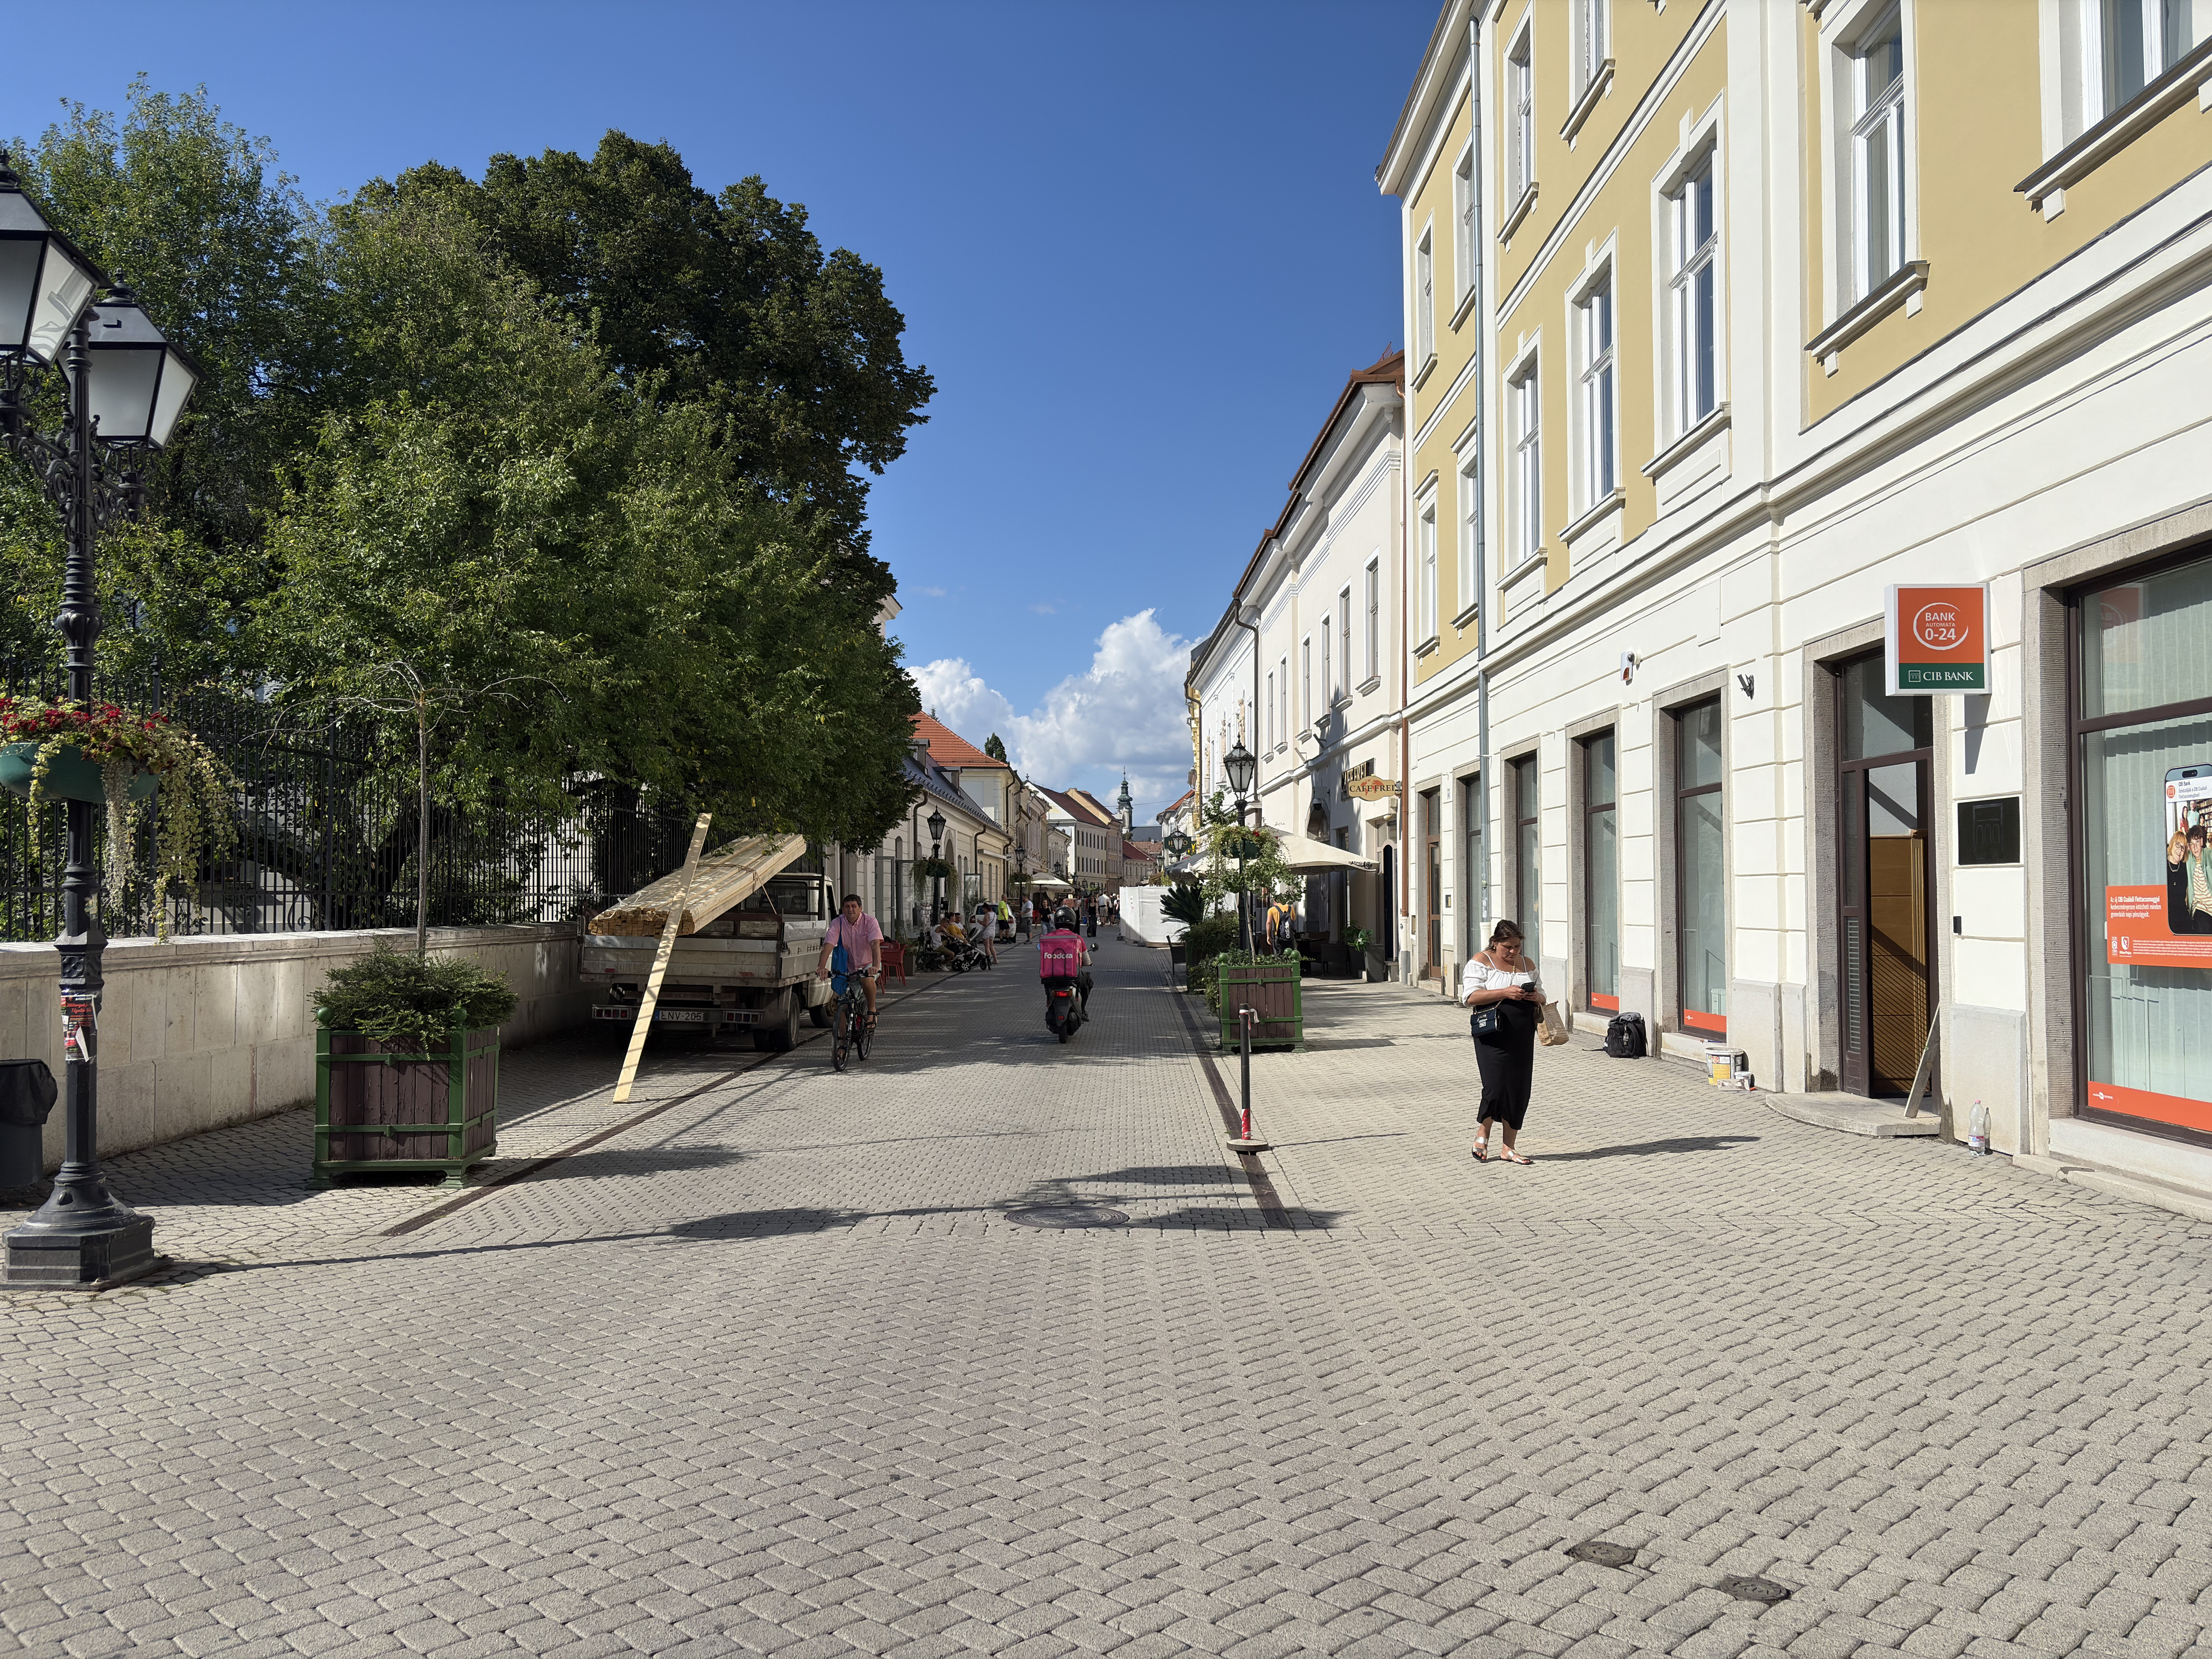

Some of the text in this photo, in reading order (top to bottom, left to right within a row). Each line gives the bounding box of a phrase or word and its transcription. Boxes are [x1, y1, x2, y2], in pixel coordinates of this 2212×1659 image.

[1926, 612, 1955, 621] BANK
[1925, 628, 1956, 640] 0-24
[1923, 671, 1974, 681] CIB BANK
[661, 1011, 702, 1021] LNV-205
